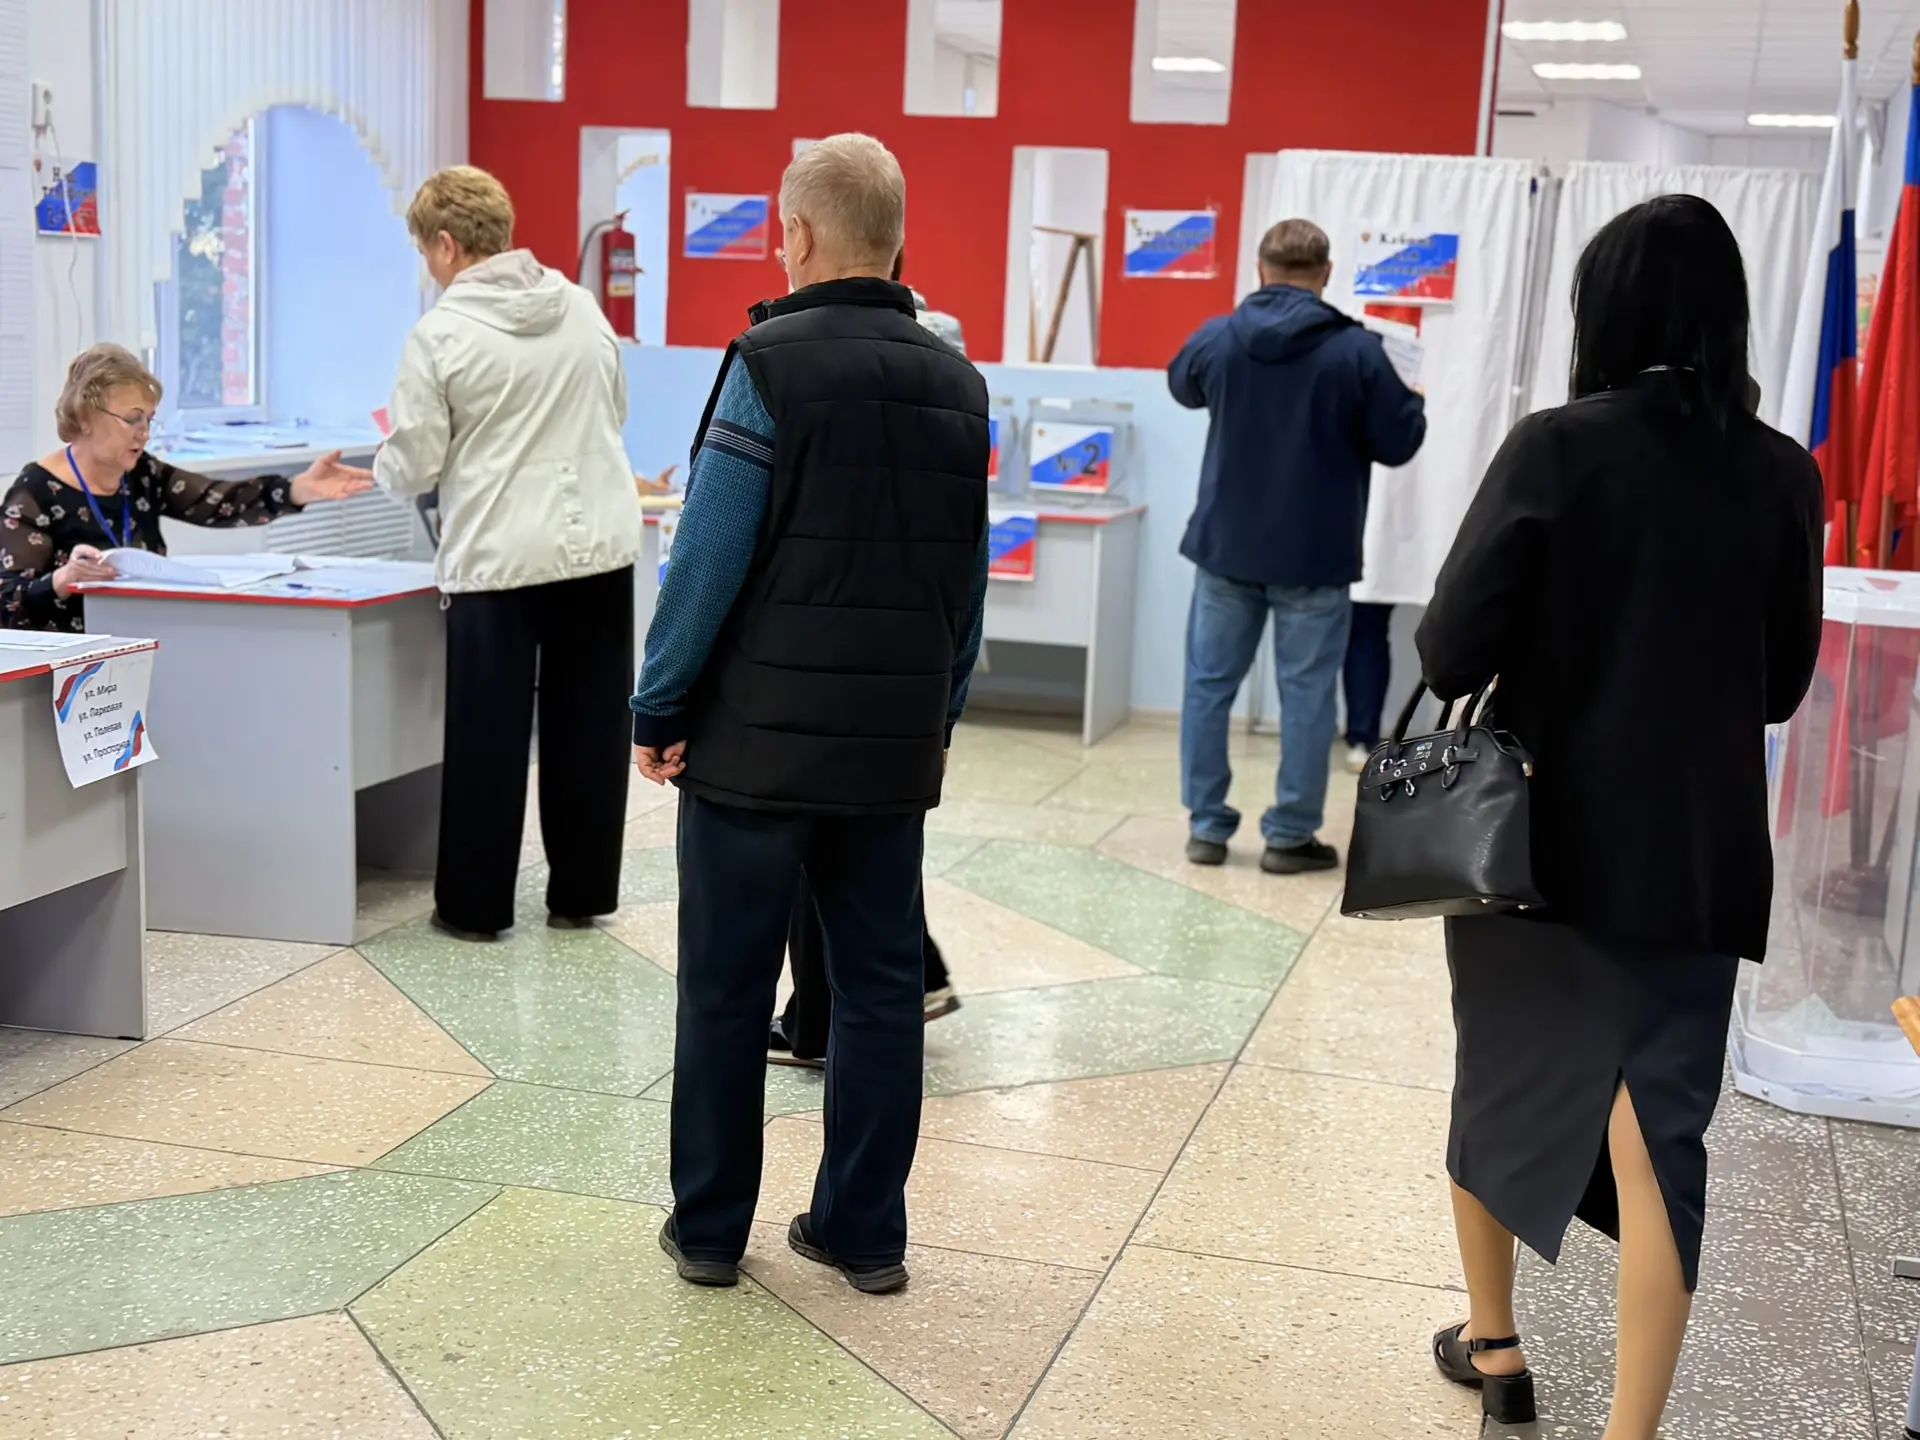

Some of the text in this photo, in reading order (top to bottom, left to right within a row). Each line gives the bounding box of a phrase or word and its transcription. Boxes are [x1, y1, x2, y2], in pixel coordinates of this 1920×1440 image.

[1081, 443, 1101, 475] 2
[97, 684, 117, 696] Мира
[90, 702, 123, 717] Парковая
[94, 722, 121, 736] Полевая
